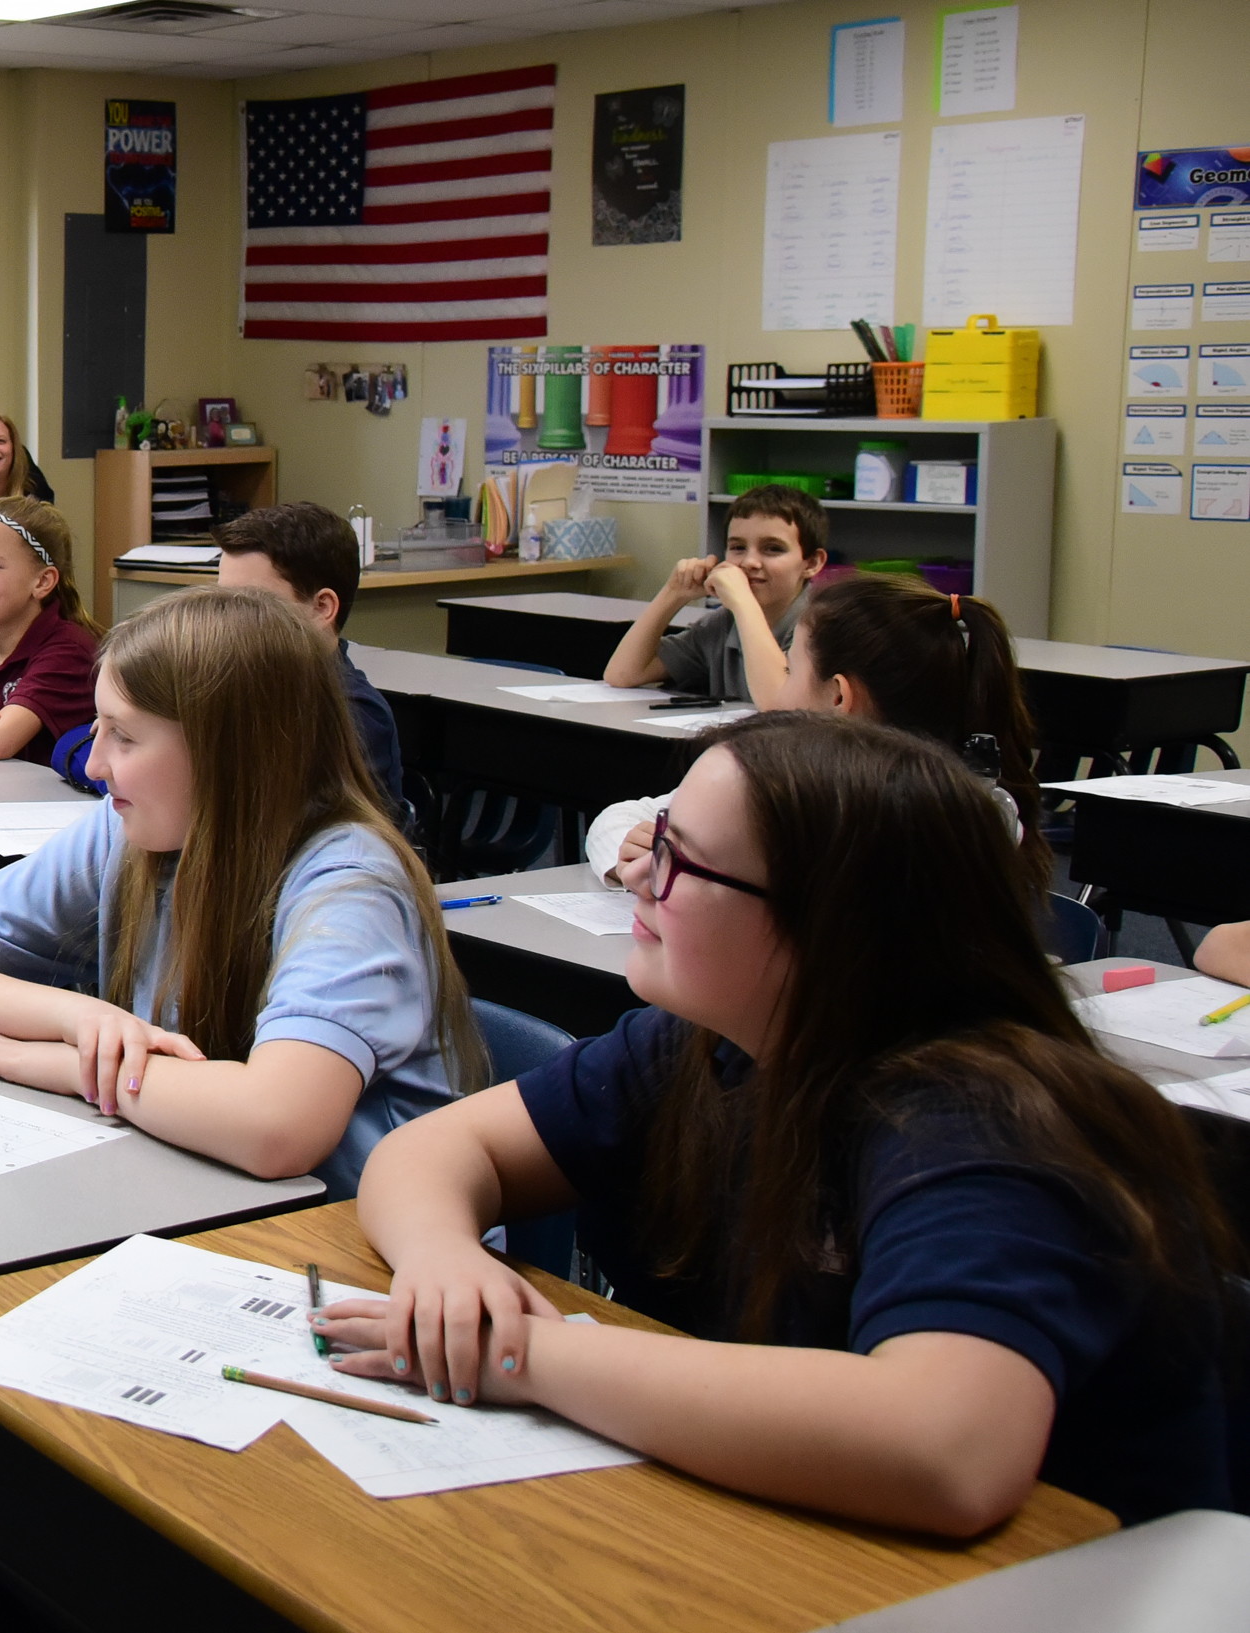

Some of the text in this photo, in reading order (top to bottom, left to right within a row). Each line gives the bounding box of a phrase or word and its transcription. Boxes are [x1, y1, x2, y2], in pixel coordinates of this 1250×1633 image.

[108, 102, 128, 126] YOU
[108, 129, 173, 153] POWER
[1190, 168, 1250, 184] Geom
[498, 362, 691, 376] THE SIX PILLARS OF CHARACTER
[503, 452, 518, 465] BE
[582, 454, 600, 467] OF
[603, 455, 678, 469] CHARACTER
